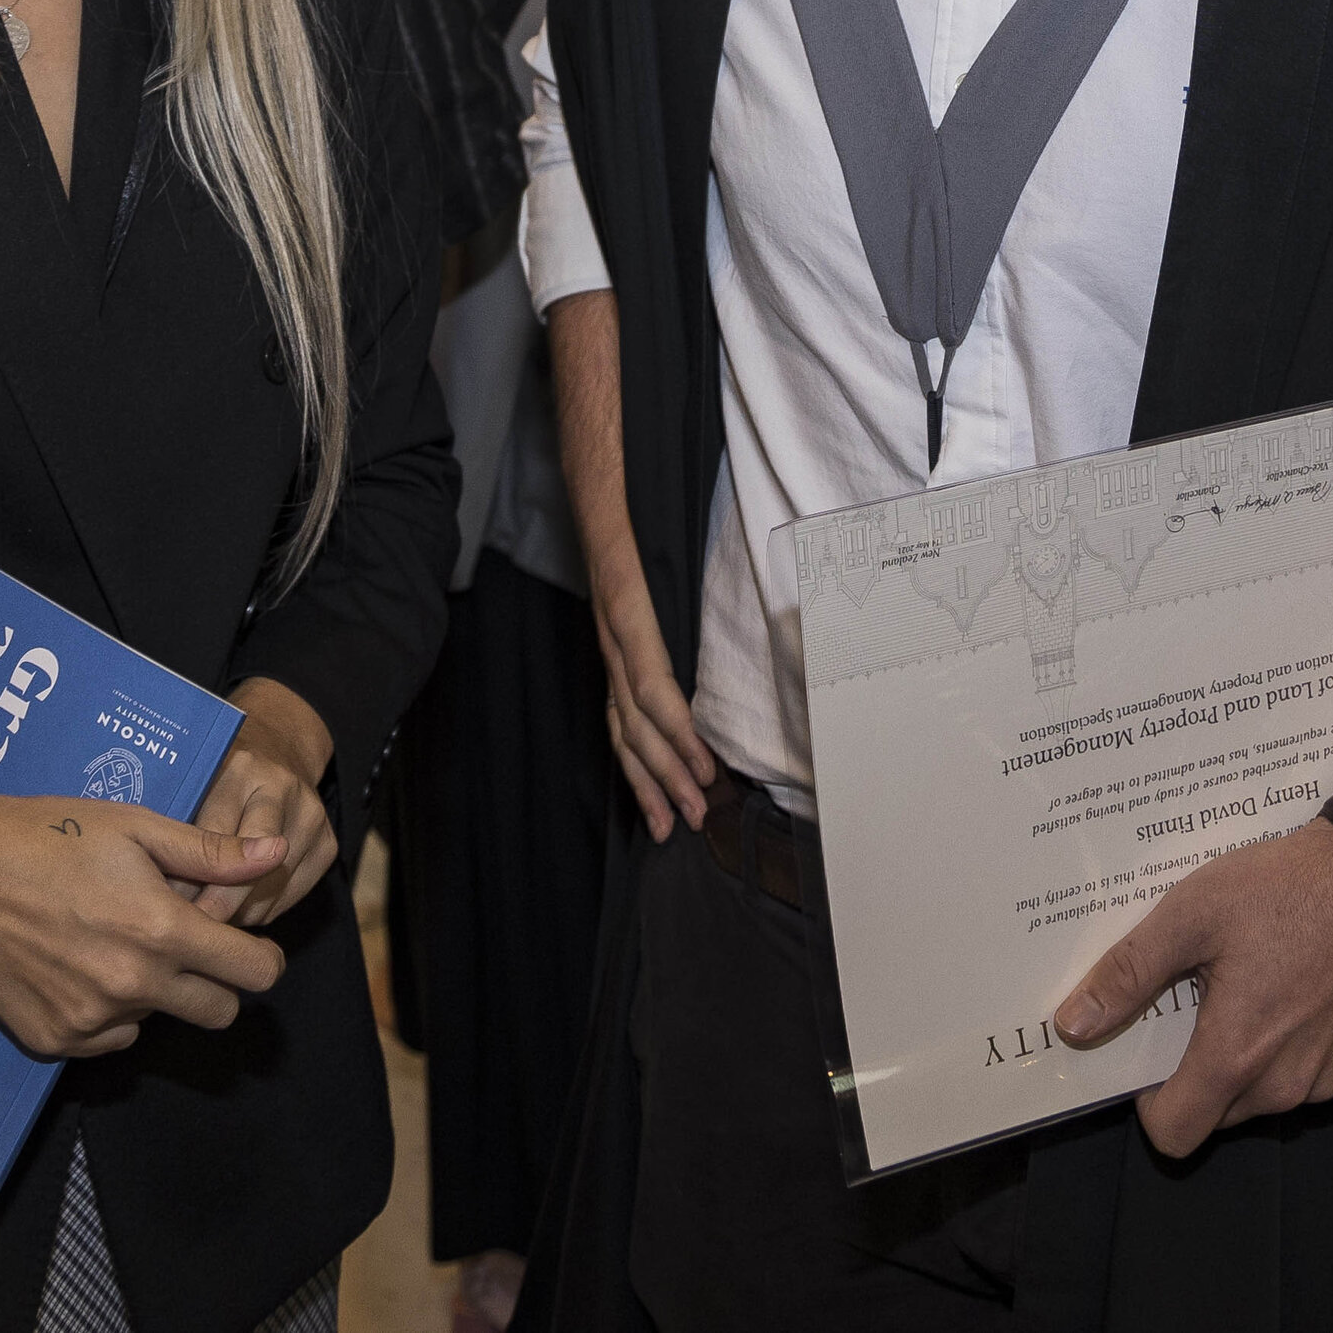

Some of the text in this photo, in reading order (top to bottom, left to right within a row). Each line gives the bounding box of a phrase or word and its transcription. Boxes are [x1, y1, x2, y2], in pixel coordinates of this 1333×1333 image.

[1265, 462, 1330, 482] Vice-Chancellor
[1176, 484, 1221, 502] Chancellor
[881, 548, 941, 570] New Zealand
[1209, 671, 1264, 695] Property
[1266, 664, 1292, 683] and
[1116, 686, 1206, 720] Management
[1265, 681, 1314, 710] Land
[1223, 694, 1261, 722] and
[115, 705, 173, 742] UNIVERSITY
[1019, 707, 1113, 743] Specialisation
[1139, 705, 1219, 739] Property
[97, 712, 178, 765] LINCOLN
[1252, 727, 1327, 754] requirements,
[1001, 727, 1135, 777] Management
[1199, 754, 1225, 769] been
[1229, 748, 1249, 761] has
[1302, 749, 1320, 763] the
[1144, 762, 1195, 787] admitted
[1242, 752, 1299, 782] prescribed
[1106, 780, 1125, 794] the
[1128, 776, 1140, 788] to
[1186, 781, 1200, 797] of
[1203, 771, 1239, 789] course
[1064, 786, 1103, 805] degree
[1128, 795, 1151, 812] and
[1154, 785, 1185, 804] study
[1047, 797, 1061, 813] of
[1085, 802, 1125, 821] having
[1136, 779, 1321, 843] Henry David Finnis
[1032, 813, 1082, 838] satisfied
[1203, 846, 1224, 860] the
[1139, 853, 1200, 877] University;
[1084, 881, 1096, 892] to
[1100, 877, 1110, 890] is
[1113, 870, 1135, 886] this
[1044, 885, 1081, 906] certify
[1110, 893, 1129, 907] the
[1132, 887, 1147, 901] by
[1016, 896, 1041, 913] that
[1045, 899, 1107, 925] legislature
[1027, 917, 1042, 933] of
